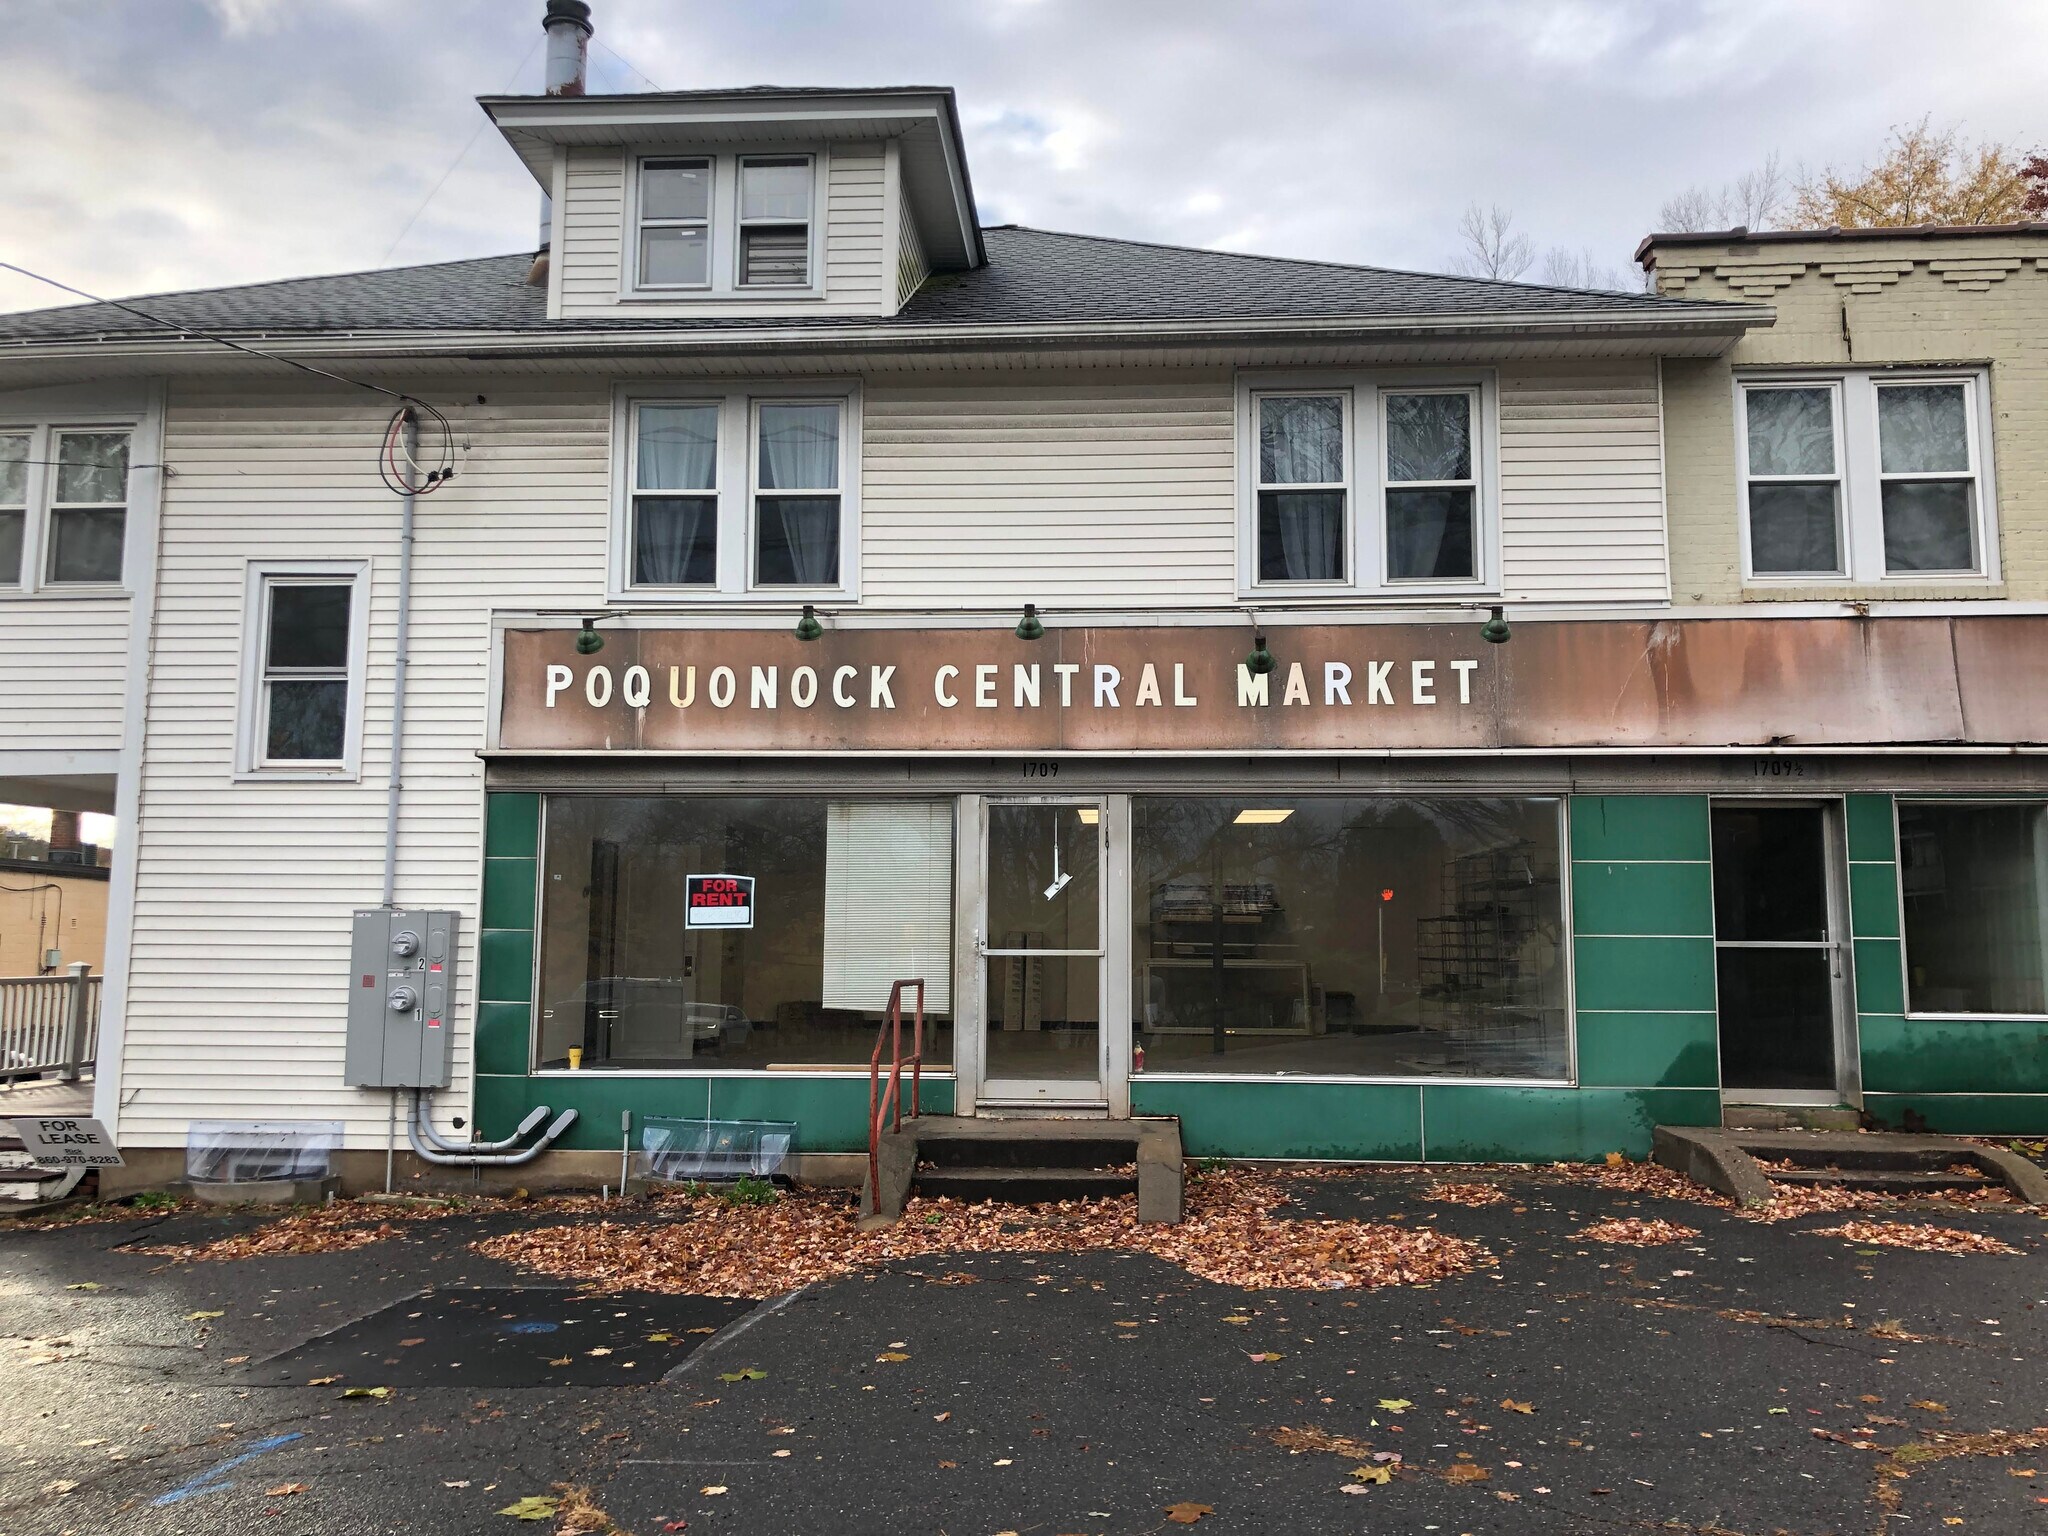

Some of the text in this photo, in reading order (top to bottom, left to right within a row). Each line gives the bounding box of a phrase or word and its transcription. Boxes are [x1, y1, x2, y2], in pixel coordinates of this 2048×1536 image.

[545, 659, 1479, 709] POQUONOCK CENTRAL MARKET
[1023, 762, 1059, 777] 1709
[702, 879, 738, 892] FOR
[692, 893, 747, 906] RENT
[418, 958, 425, 970] 2
[416, 1008, 422, 1021] 1
[39, 1120, 80, 1132] FOR
[38, 1133, 101, 1145] LEASE
